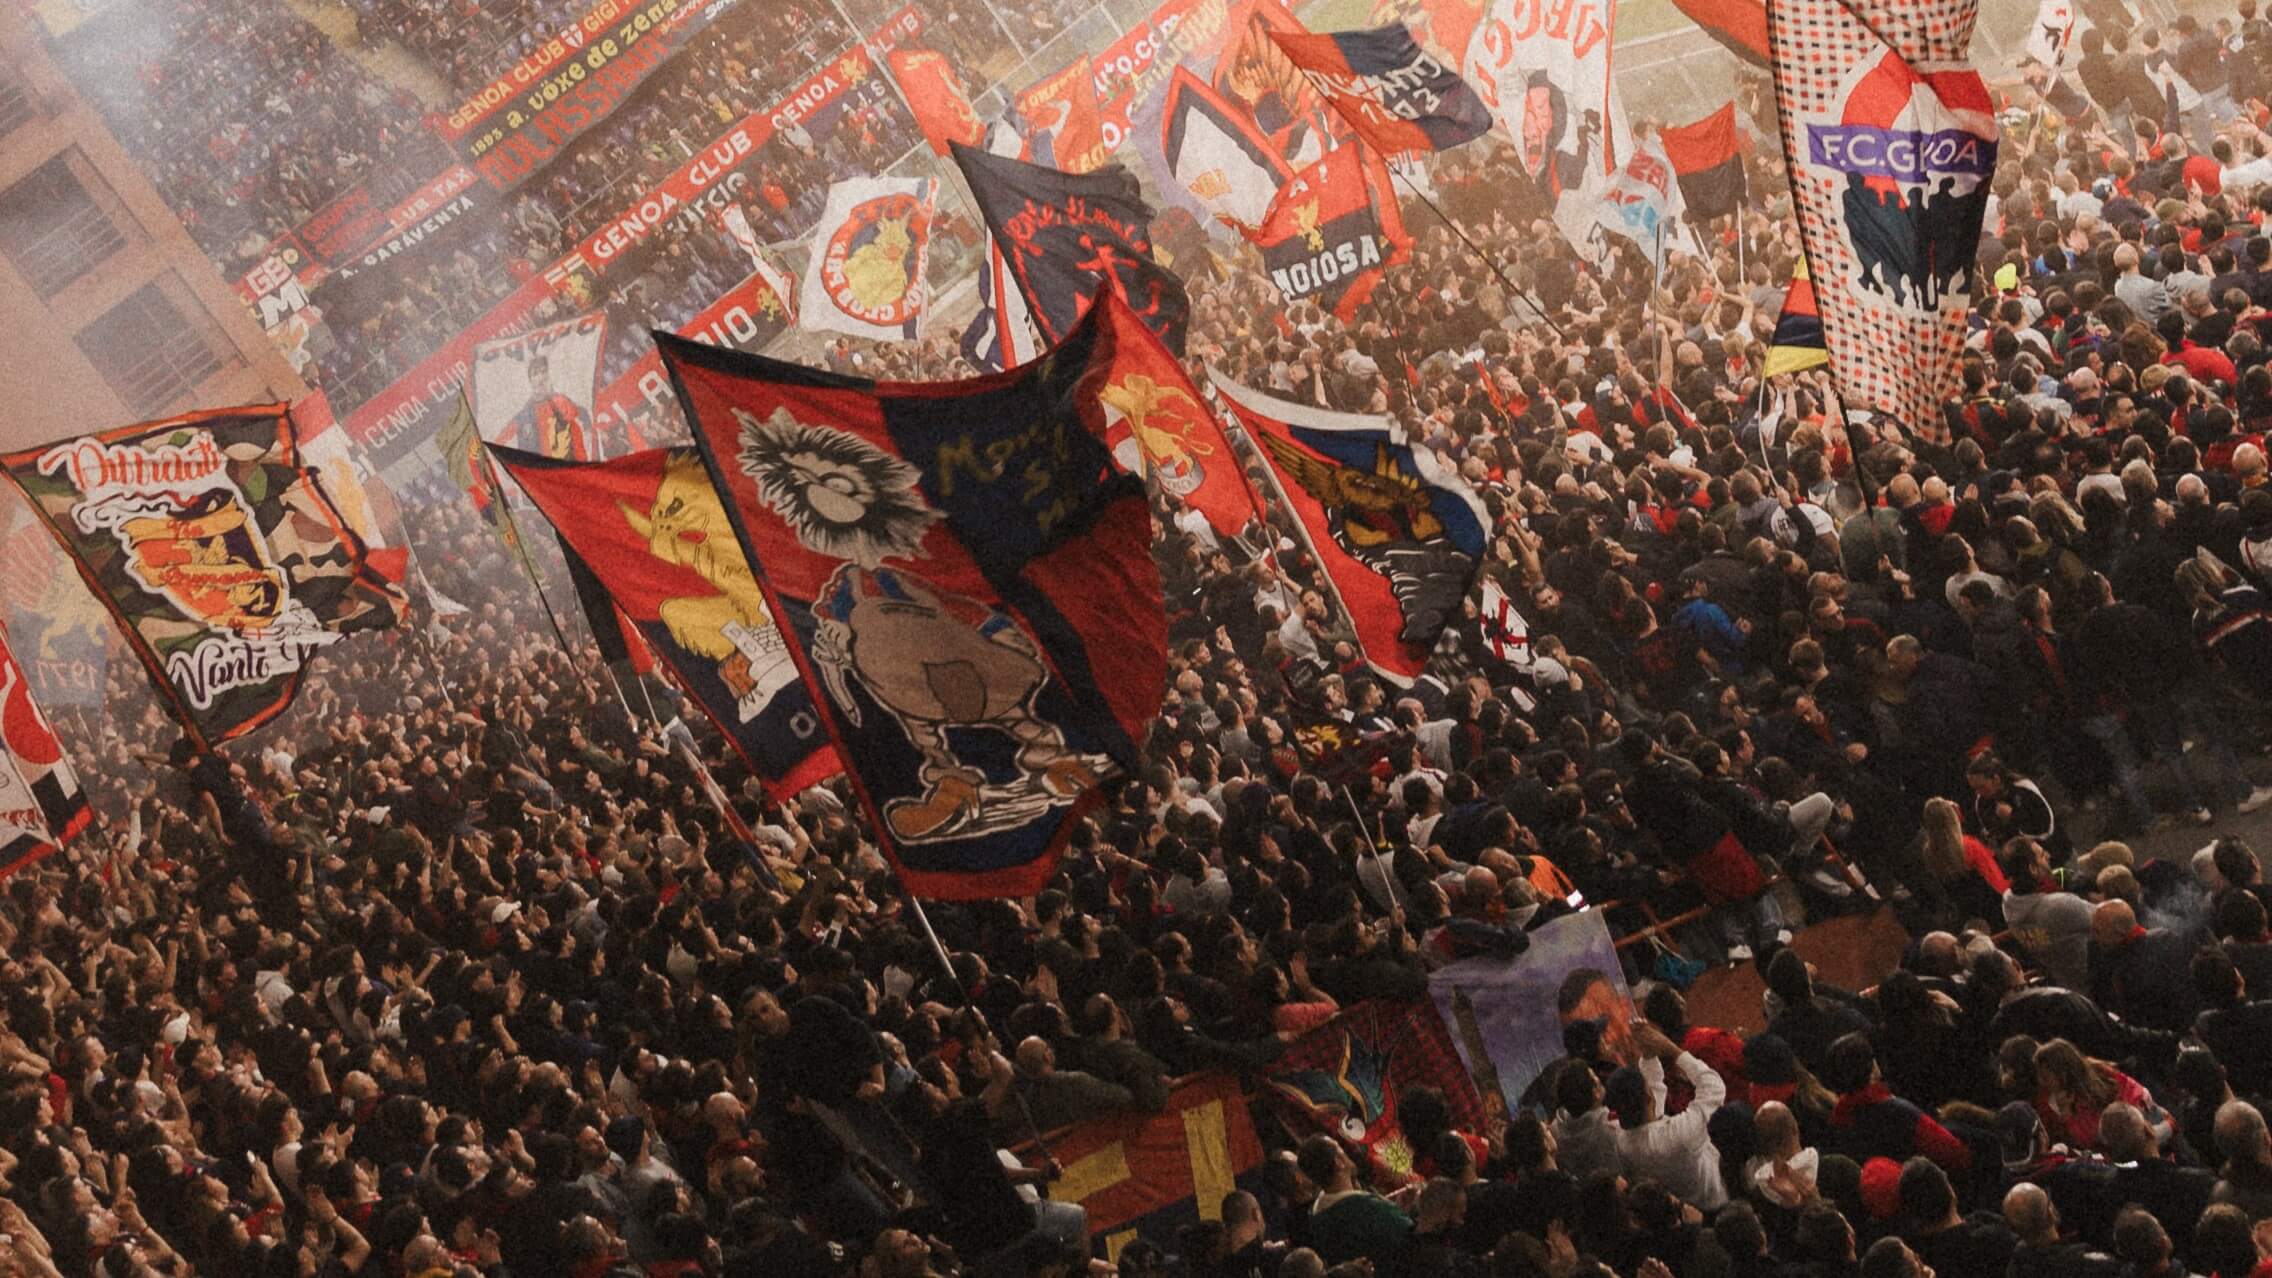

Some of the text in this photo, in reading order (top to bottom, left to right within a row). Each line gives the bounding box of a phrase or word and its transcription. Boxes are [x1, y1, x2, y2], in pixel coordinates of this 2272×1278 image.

[449, 80, 512, 129] GENOA
[513, 38, 566, 82] CLUB
[587, 38, 619, 69] de
[770, 75, 839, 131] GENOA
[592, 129, 753, 259] GENOA CLUB
[363, 194, 475, 267] GARAVENTA
[363, 394, 430, 450] GENOA
